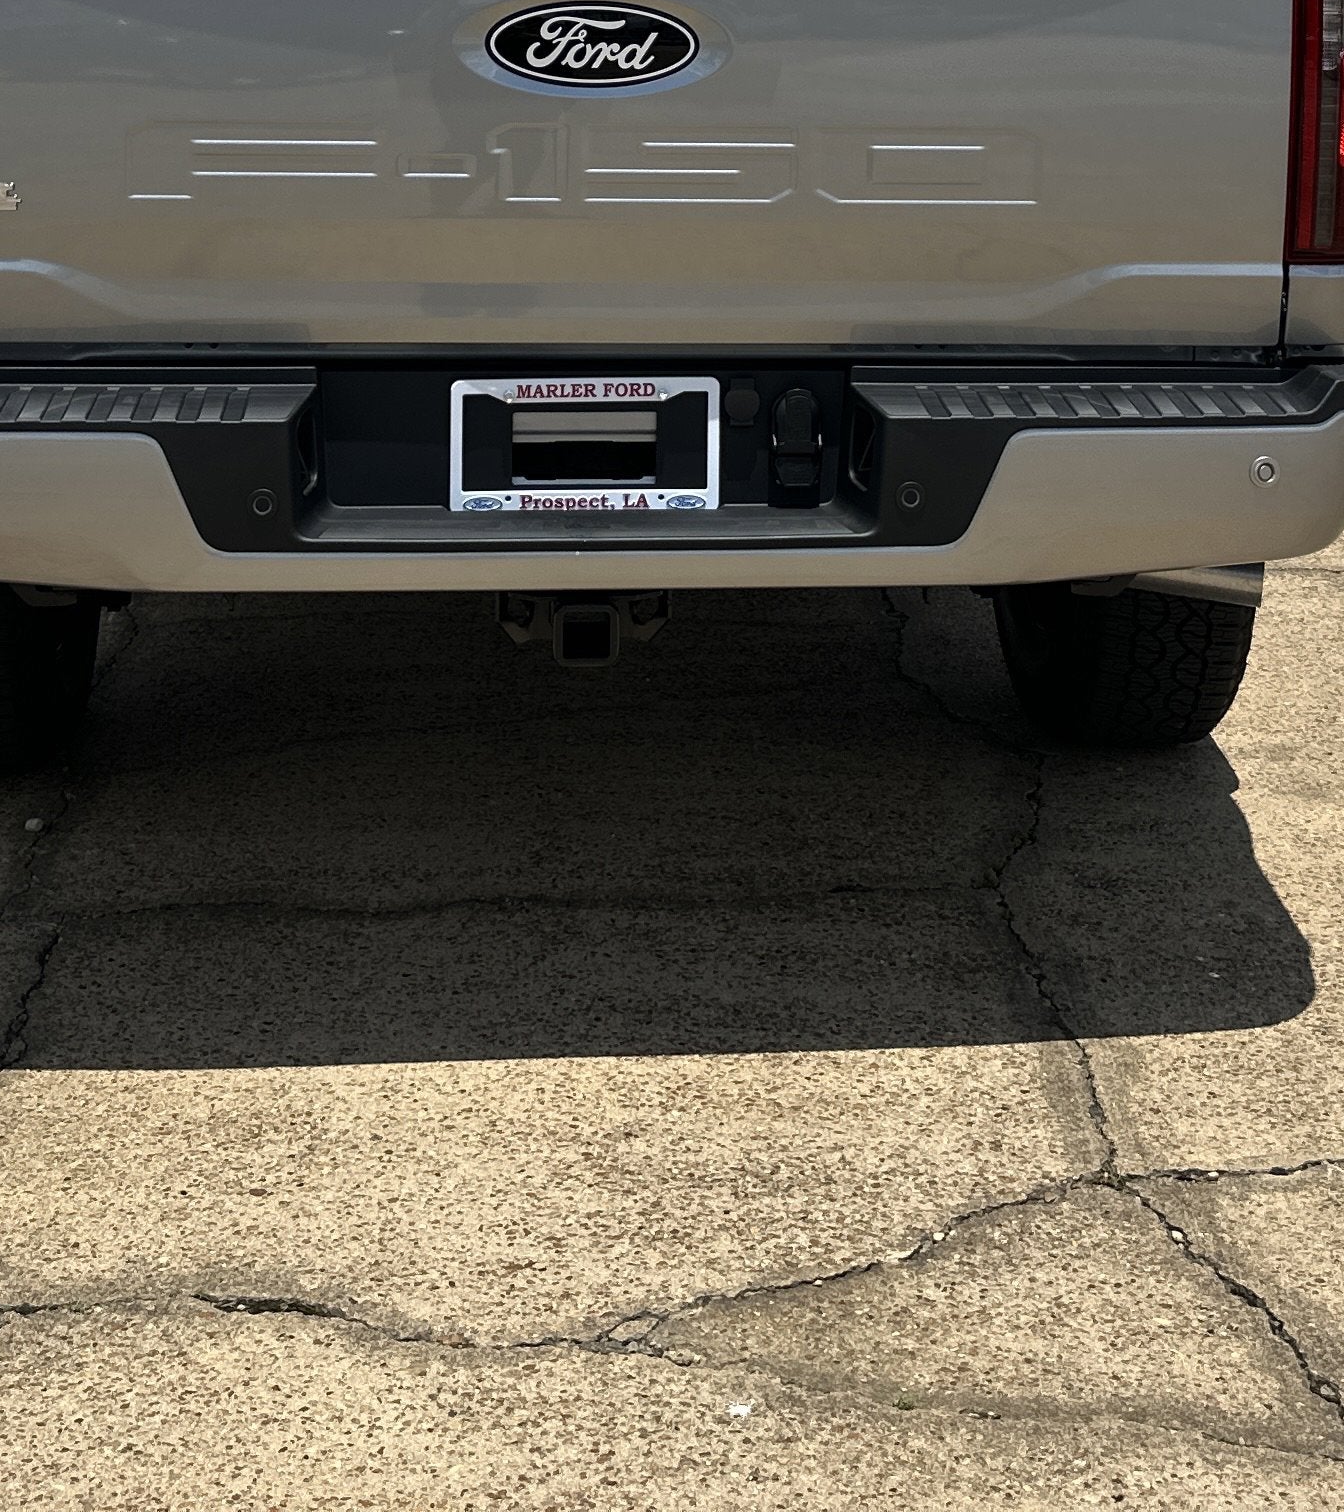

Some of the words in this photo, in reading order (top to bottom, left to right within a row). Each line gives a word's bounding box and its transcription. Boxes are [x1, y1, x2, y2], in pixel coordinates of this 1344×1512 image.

[525, 15, 659, 70] Ford
[124, 120, 1040, 205] F-150
[516, 384, 598, 399] MARLER
[603, 382, 656, 398] FORD
[519, 493, 615, 510] Prospect,
[622, 492, 650, 508] LA
